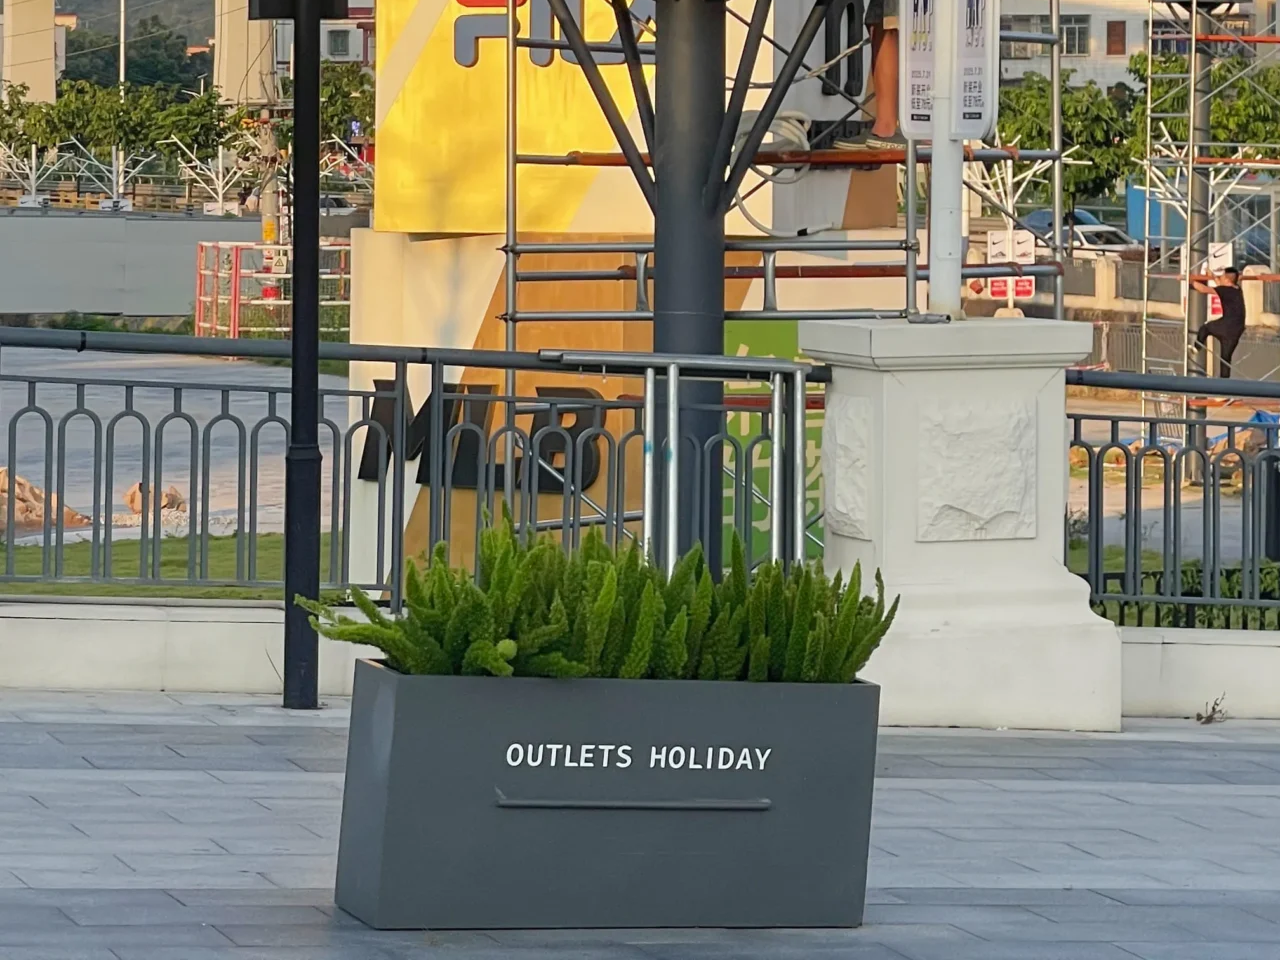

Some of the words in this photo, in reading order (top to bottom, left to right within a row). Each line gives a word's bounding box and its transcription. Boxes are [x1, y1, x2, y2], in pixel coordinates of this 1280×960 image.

[357, 379, 607, 494] MLB
[506, 743, 632, 768] OUTLETS
[649, 746, 772, 771] HOLIDAY
